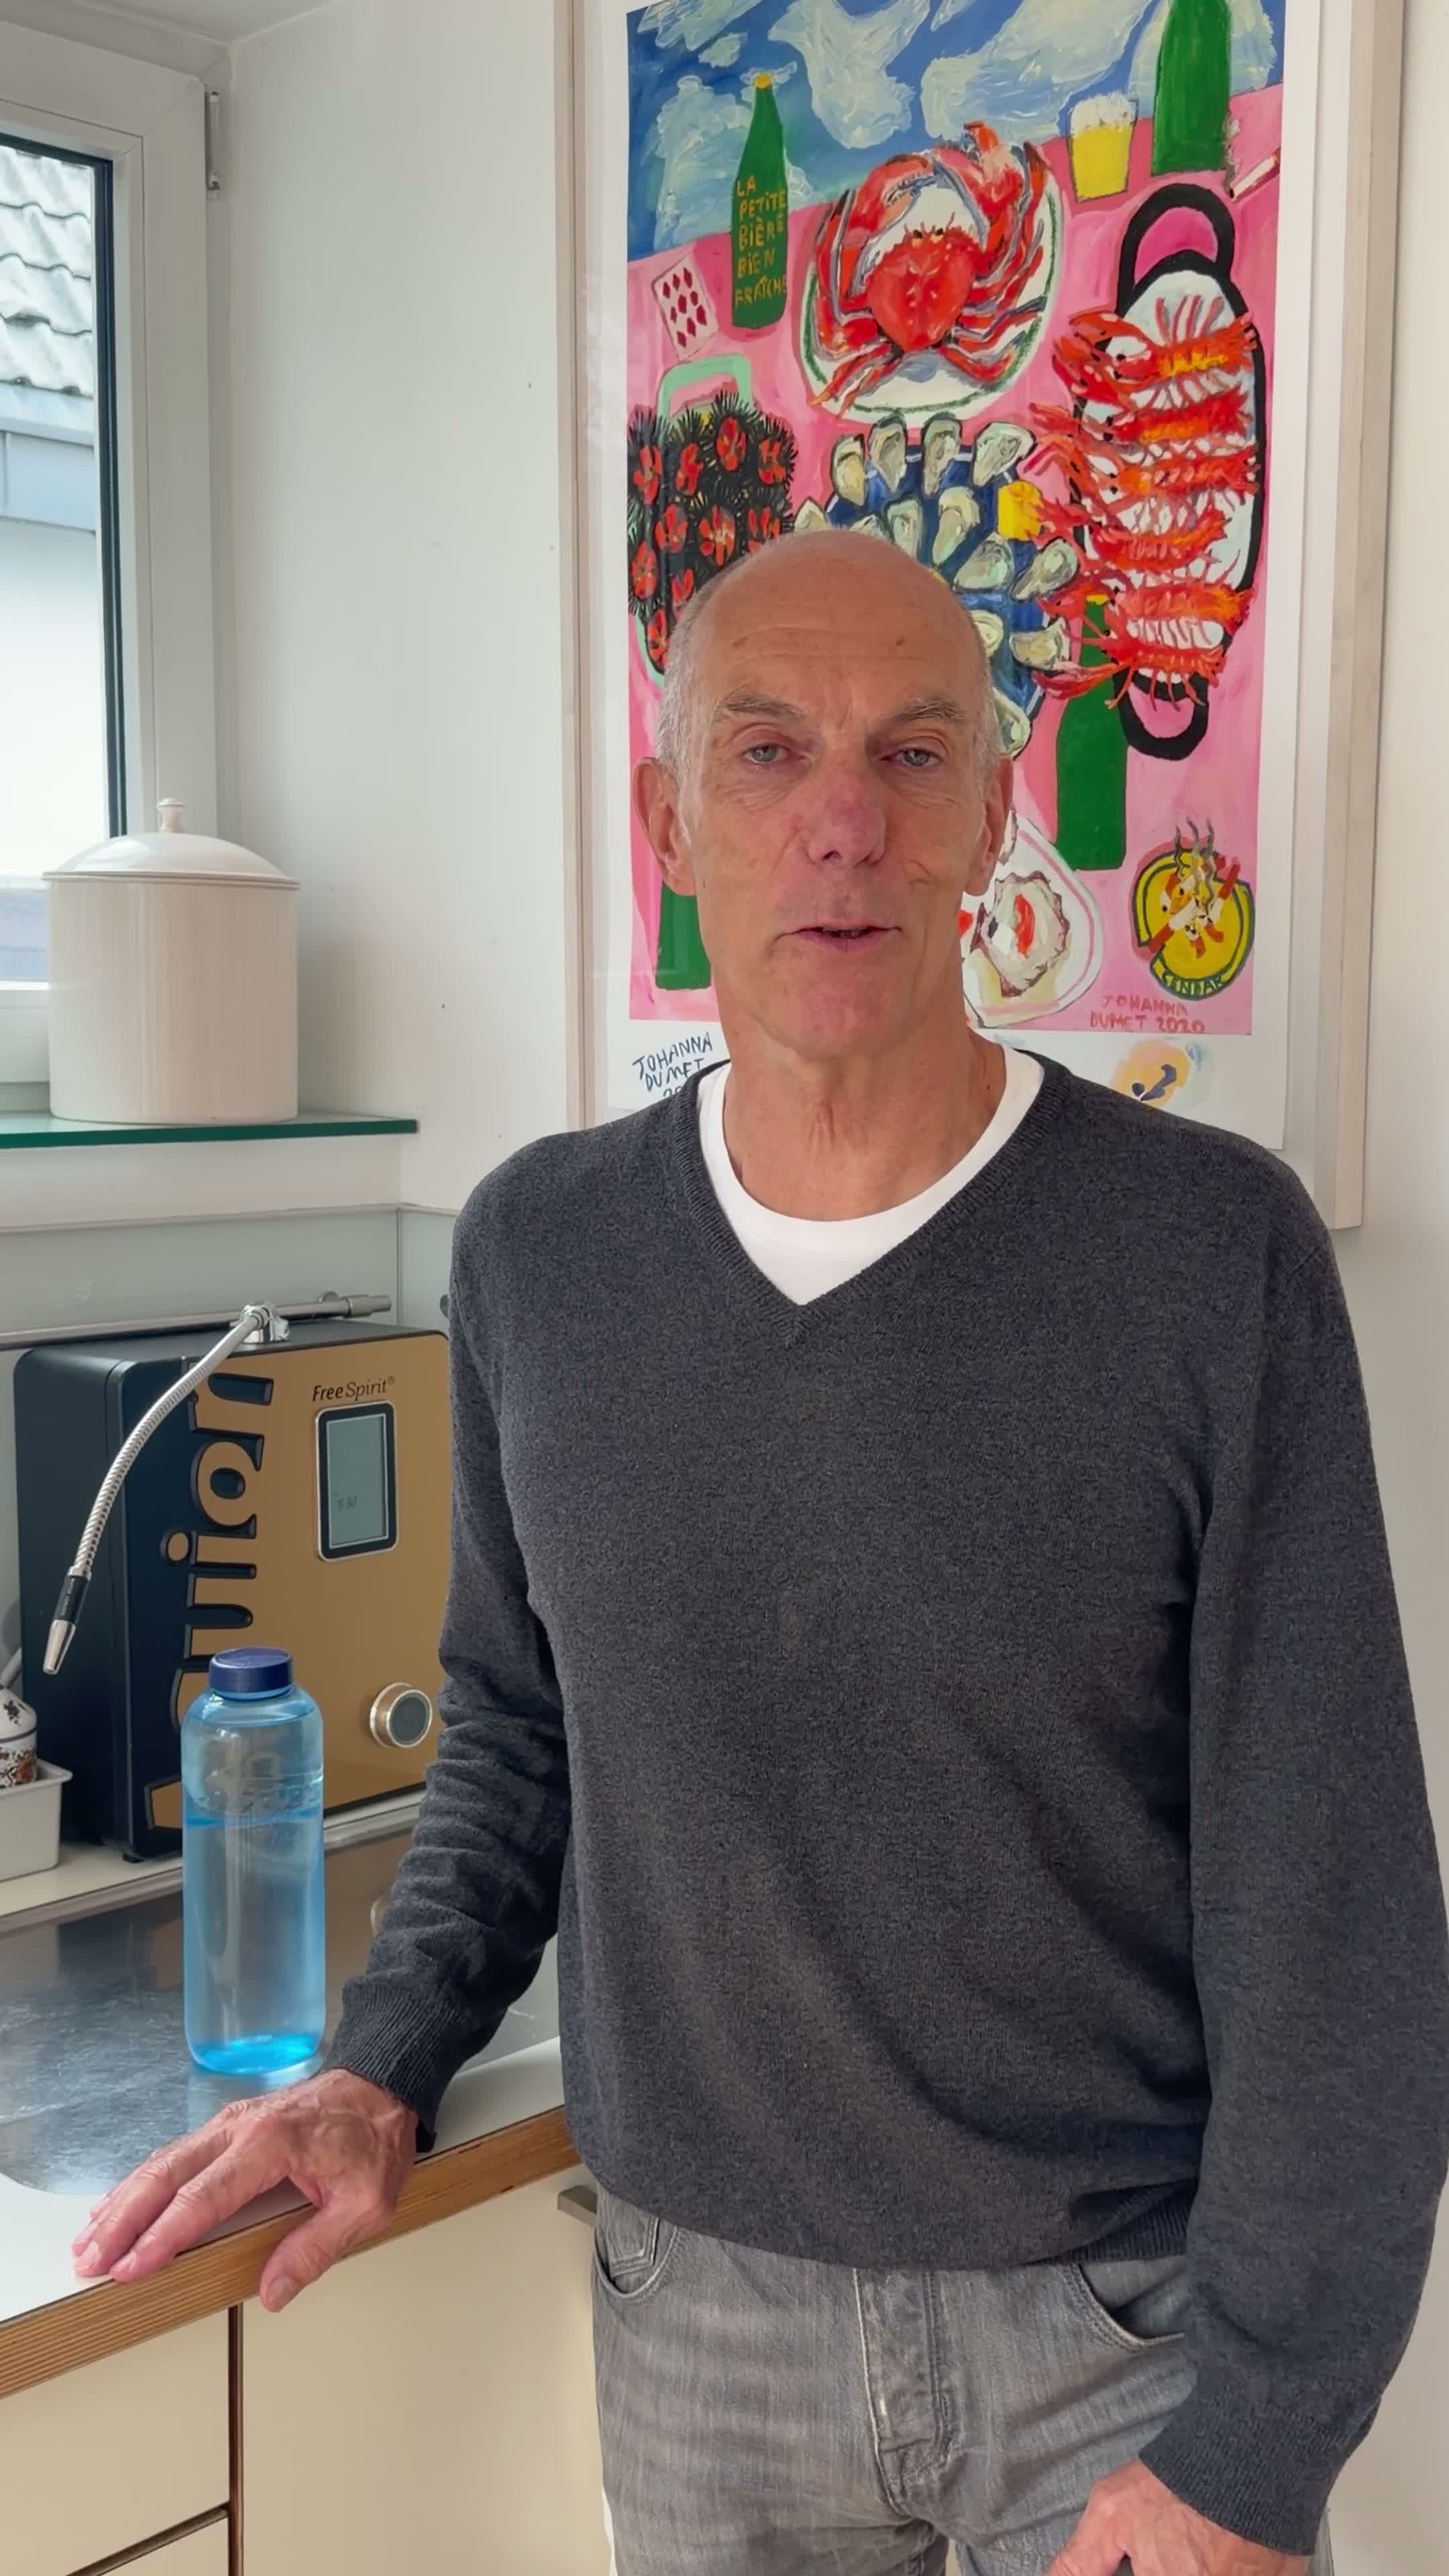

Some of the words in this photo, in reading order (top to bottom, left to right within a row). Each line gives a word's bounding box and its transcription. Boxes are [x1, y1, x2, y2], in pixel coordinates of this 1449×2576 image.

[737, 175, 756, 197] LA
[1101, 994, 1189, 1016] JOHANNA
[1156, 1016, 1206, 1034] 2020
[632, 1031, 713, 1079] JOHANNA
